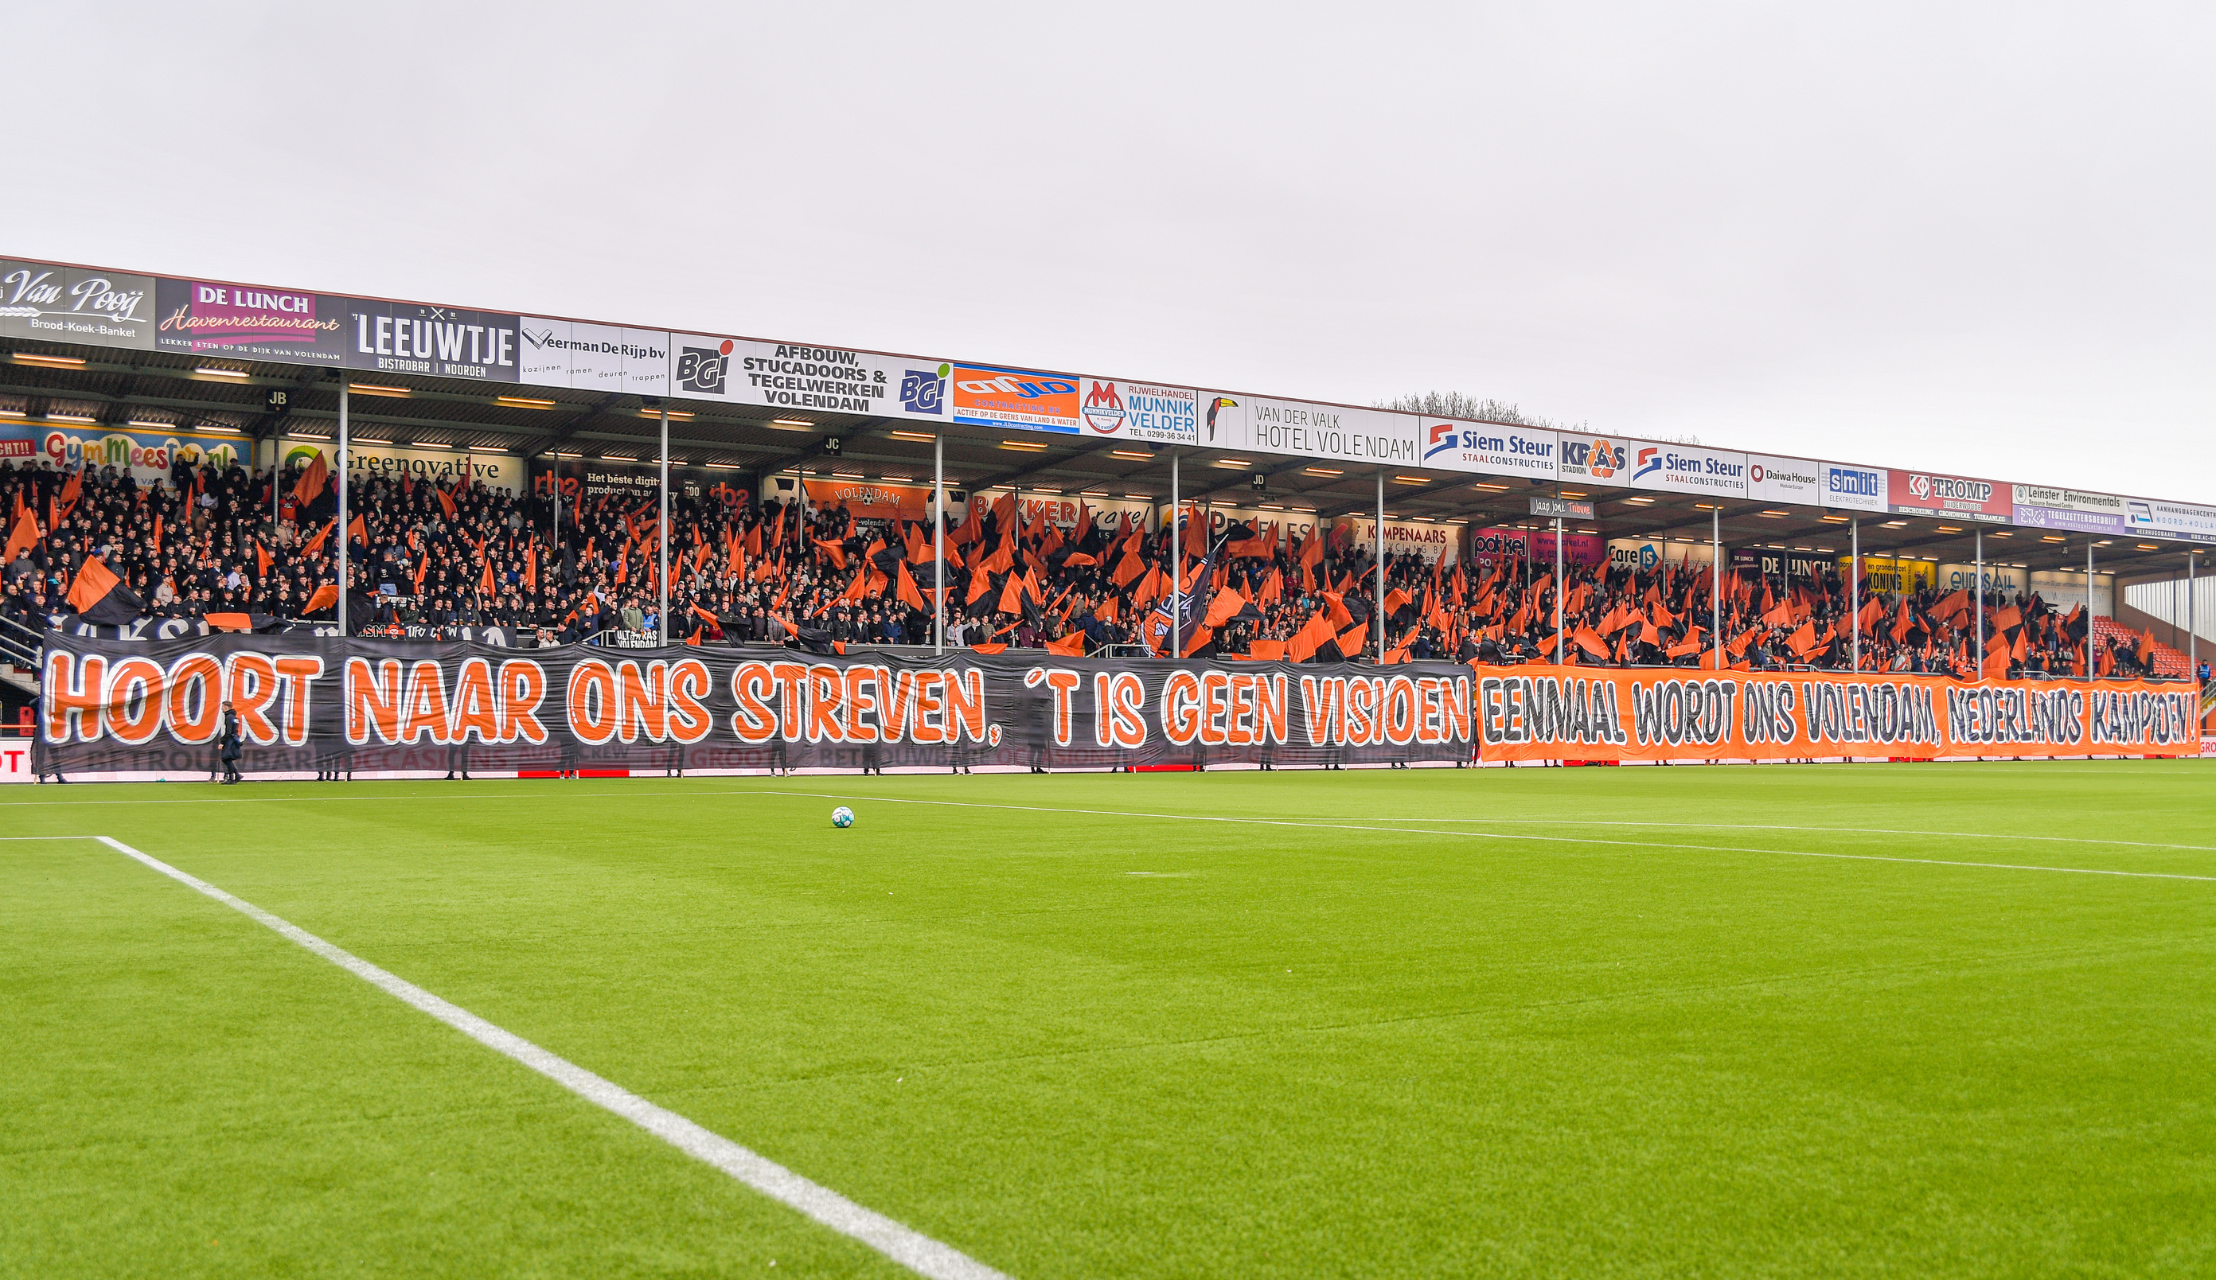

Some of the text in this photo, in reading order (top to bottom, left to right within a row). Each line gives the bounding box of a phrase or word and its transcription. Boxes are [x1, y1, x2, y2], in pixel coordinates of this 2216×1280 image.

[4, 270, 63, 305] Van
[200, 287, 310, 314] DE LUNCH
[160, 304, 340, 332] Havenrestaurant
[32, 318, 136, 338] Brood-Koek-Banket
[161, 338, 341, 361] LEKKER ETEN OP DE DIJK VAN VOLENDAM
[358, 314, 513, 367] LEEUWTJE
[601, 342, 619, 355] De
[621, 344, 647, 359] Rijp
[649, 347, 666, 359] bv
[775, 344, 860, 367] AFBOUW,
[378, 357, 487, 378] BISTROBAR NOORDEN
[522, 365, 666, 382] kozijnen ramen deuren trappen
[743, 358, 888, 385] STUCADOORS &
[748, 373, 885, 398] TEGELWERKEN
[1014, 381, 1077, 399] JLD
[1128, 386, 1194, 400] RIJWIELHANDEL
[269, 391, 287, 405] JB
[764, 390, 869, 412] VOLENDAM
[974, 399, 1044, 413] CONTRACTING
[1129, 395, 1194, 416] MUNNIK
[957, 408, 979, 417] ACTIEF
[989, 411, 998, 419] DE
[999, 412, 1019, 421] GRENS
[1034, 416, 1050, 424] LAND
[1057, 418, 1077, 427] WATER
[1129, 411, 1195, 432] VELDER
[1255, 405, 1340, 429] VAN DER VALK
[826, 438, 839, 450] JC
[1129, 428, 1195, 441] TEL. 0299-36 34 41
[1256, 424, 1414, 461] HOTEL VOLENDAM
[1463, 430, 1553, 457] Siem Steur
[334, 449, 499, 479] Greenovatve
[1462, 453, 1554, 470] STAALCONSTRUCTIES
[1562, 441, 1626, 470] KRAS
[1665, 453, 1744, 477] Siem Steur
[587, 473, 605, 483] Het
[1562, 465, 1587, 475] STADION
[1766, 469, 1816, 484] Daiwa House
[1253, 475, 1264, 485] JD
[1665, 474, 1744, 489] STAALCONSTRUCTIES
[1831, 472, 1877, 495] smit
[1932, 477, 1992, 502] TROMP
[587, 486, 641, 497] producton
[834, 486, 901, 505] VOLENDAM
[1829, 495, 1878, 506] ELEKTROTECHNIEK
[2028, 485, 2120, 508] Leinster Environmentals
[1938, 510, 1971, 519] GRONDWERK
[1943, 500, 1982, 511] ZUIDERWOUDE
[2047, 510, 2118, 526] TEGELZETTERSBEDRIJF
[2156, 517, 2216, 529] NOORD-HOLLA
[1367, 524, 1447, 544] KMPENAARS
[1536, 537, 1589, 548] www.atkel.nl
[1367, 541, 1427, 555] RYCLING
[1608, 545, 1638, 564] Care
[1643, 551, 1654, 564] IS
[1762, 557, 1780, 574] DE
[1876, 564, 1906, 573] grondvrzet
[1867, 572, 1902, 591] KONING
[43, 649, 325, 746] HOORT
[344, 657, 549, 746] NAAR
[566, 657, 714, 746] ONS
[731, 660, 1003, 748] STREVEN,
[1094, 671, 1148, 749] IS
[1161, 669, 1288, 747] GEEN
[1300, 674, 1471, 747] VISIOEN
[1480, 675, 1628, 747] EENMAAL
[1631, 678, 1738, 748] WORDT
[1742, 679, 1796, 746] ONS
[1945, 685, 2082, 746] NEDERLANDS
[0, 750, 25, 772] T
